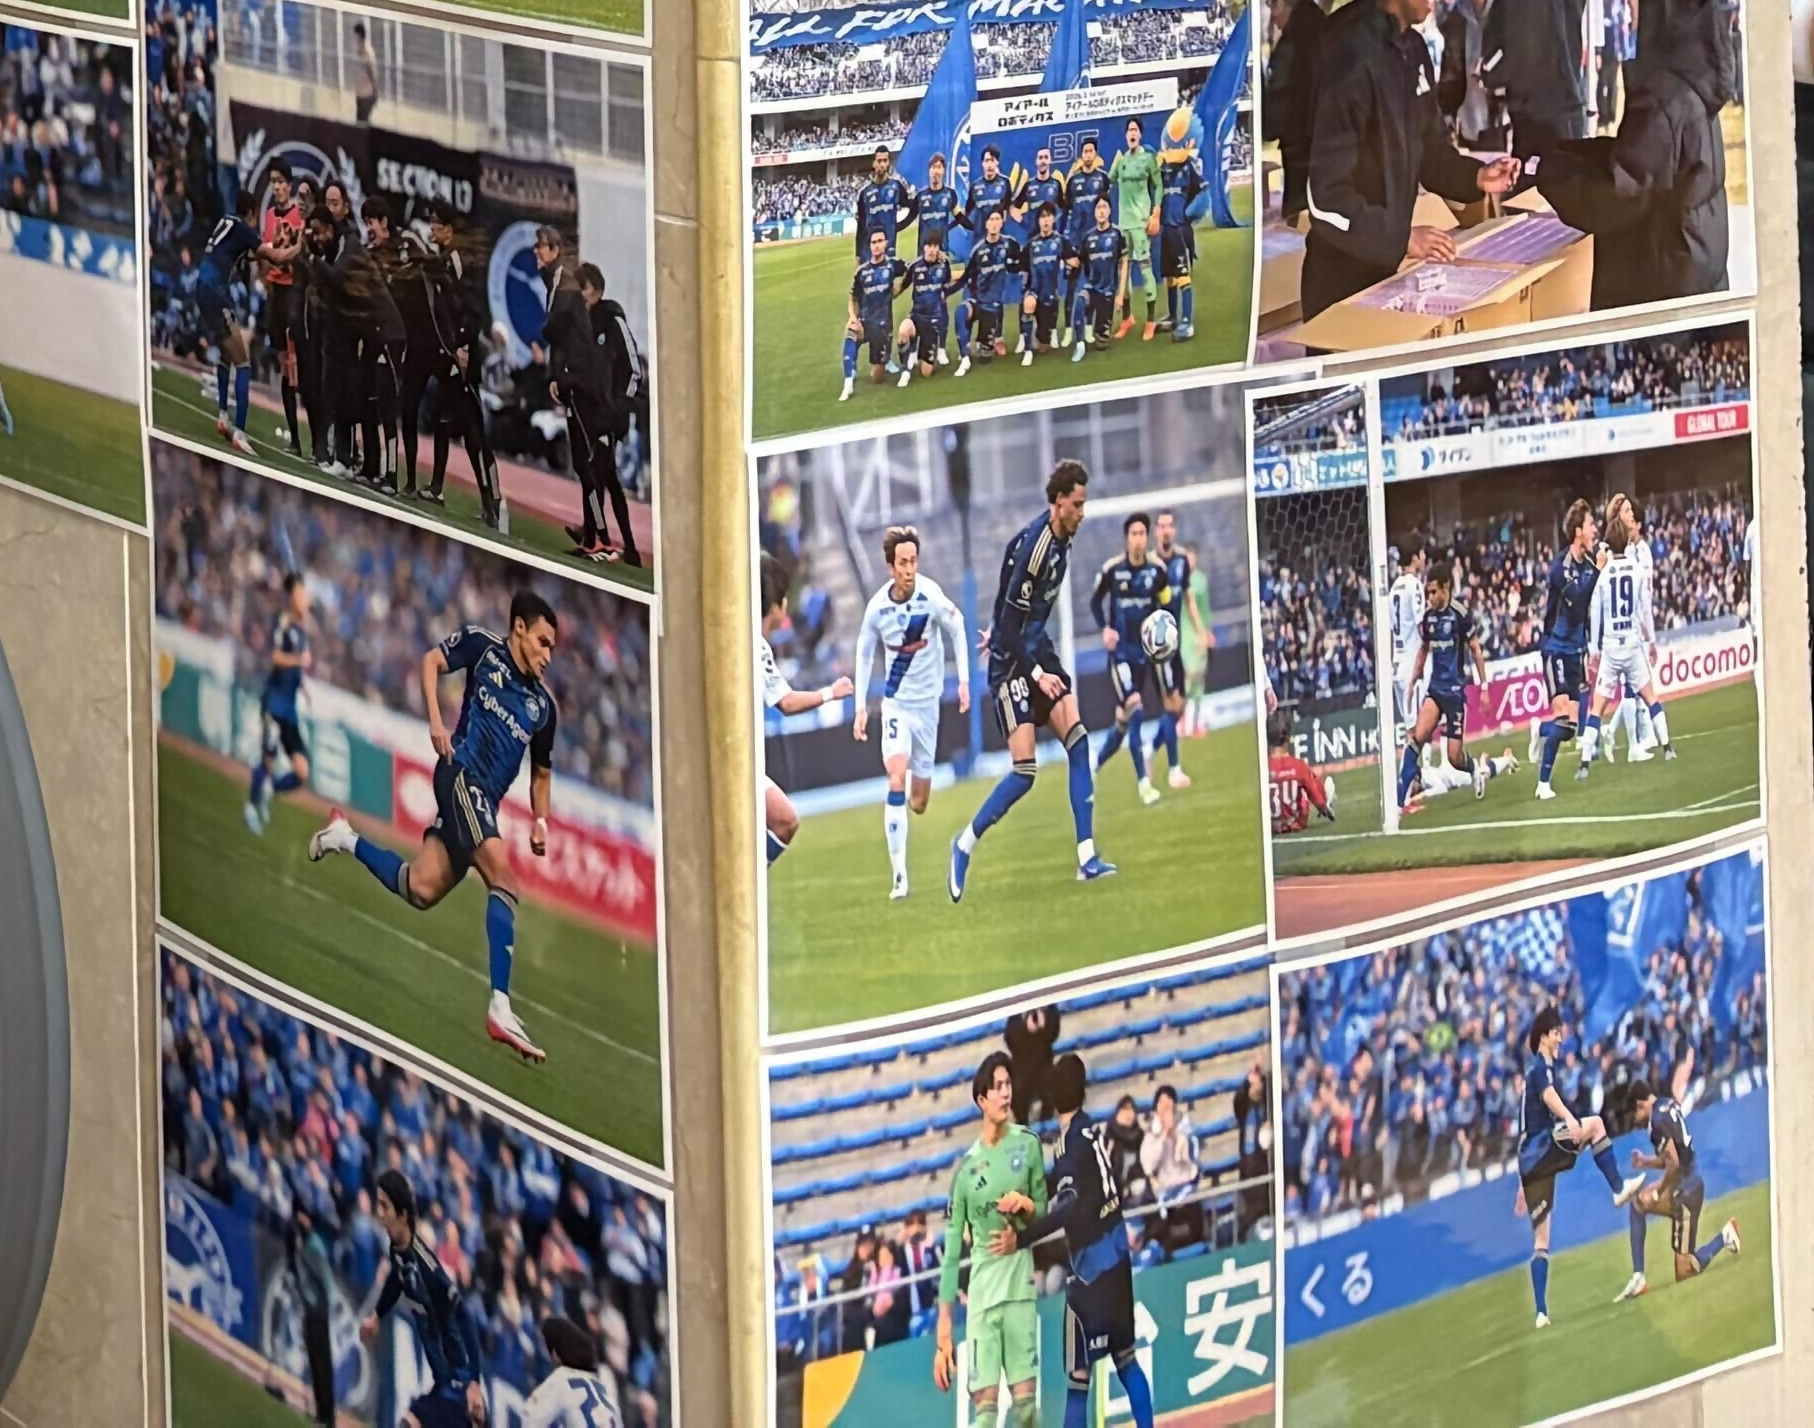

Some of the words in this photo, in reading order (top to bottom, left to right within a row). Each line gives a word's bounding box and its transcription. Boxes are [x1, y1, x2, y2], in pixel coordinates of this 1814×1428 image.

[834, 0, 955, 39] FOR
[1609, 574, 1634, 618] 19
[1659, 644, 1752, 687] docomo
[1301, 1251, 1373, 1318] くる
[1183, 1257, 1273, 1398] 安
